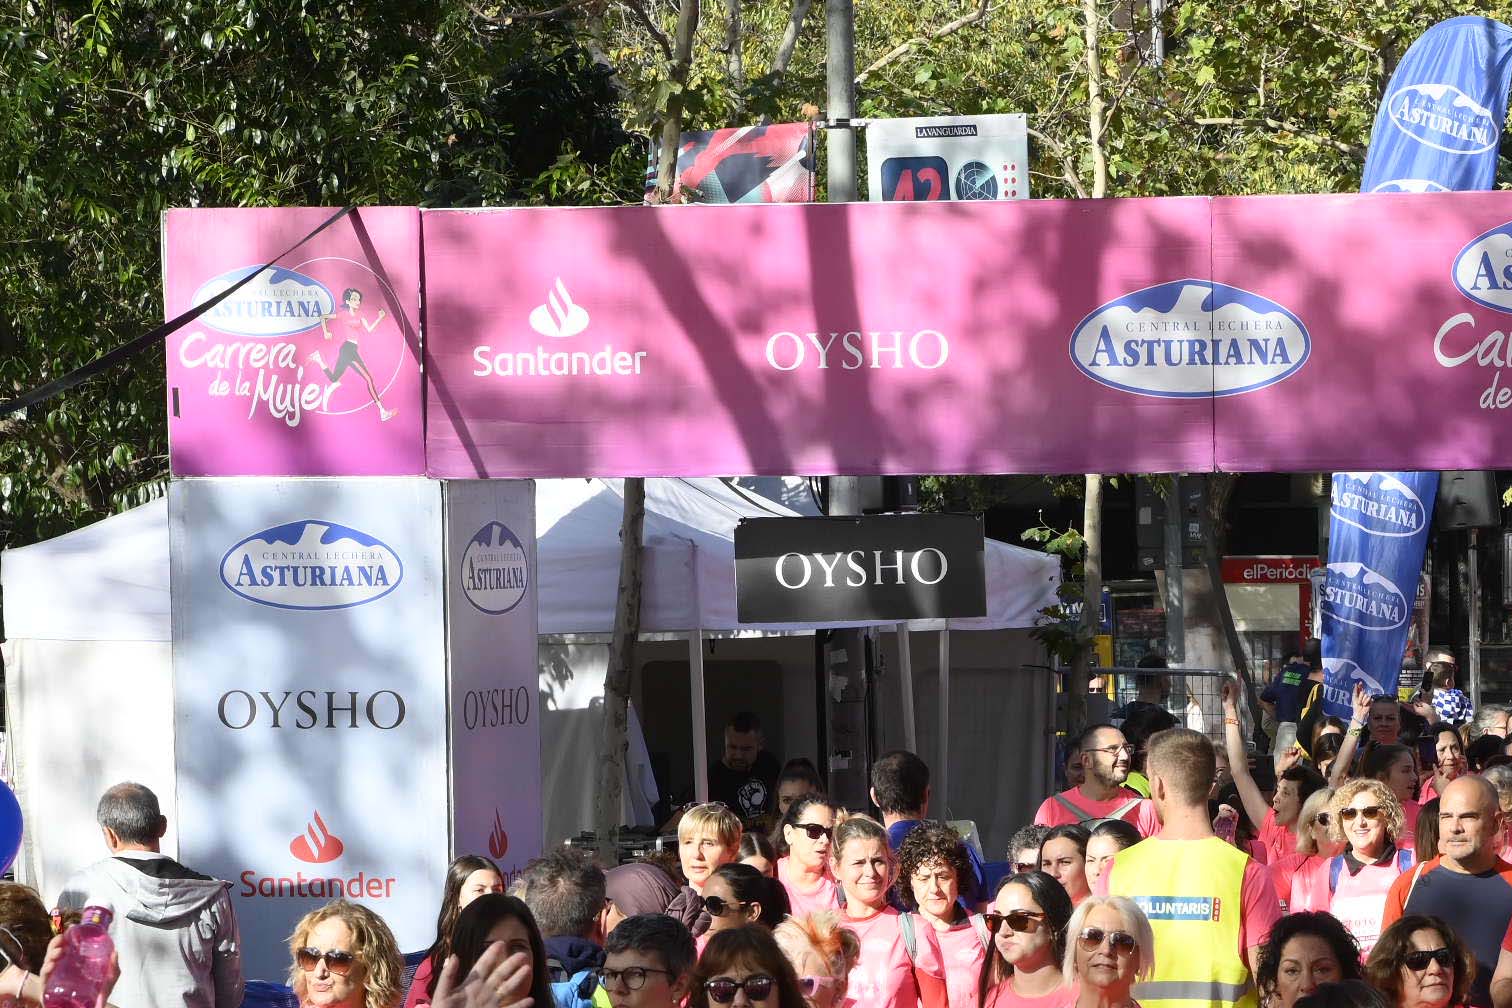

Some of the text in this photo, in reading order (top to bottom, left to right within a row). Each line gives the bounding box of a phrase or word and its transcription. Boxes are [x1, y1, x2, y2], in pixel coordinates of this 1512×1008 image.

[1398, 95, 1488, 147] ASTURIANA
[1126, 319, 1284, 332] CENTRAL LECHERA
[179, 332, 297, 369] Carrera
[473, 345, 647, 377] Santander
[765, 329, 950, 371] OYSHO
[1090, 323, 1291, 368] ASTURIANA
[208, 366, 342, 427] de la Mujer
[1479, 371, 1512, 409] de
[1330, 480, 1417, 530] ASTURIANA
[235, 552, 390, 587] ASTURIANA
[262, 551, 384, 561] CENTRAL LECHERA
[466, 556, 524, 592] ASTURIANA
[774, 547, 948, 590] OYSHO
[1325, 585, 1399, 623] STURIANA
[217, 689, 406, 730] OYSHO
[463, 685, 530, 730] OYSHO
[240, 870, 396, 899] Santander
[1139, 900, 1210, 915] OLUNTARIS
